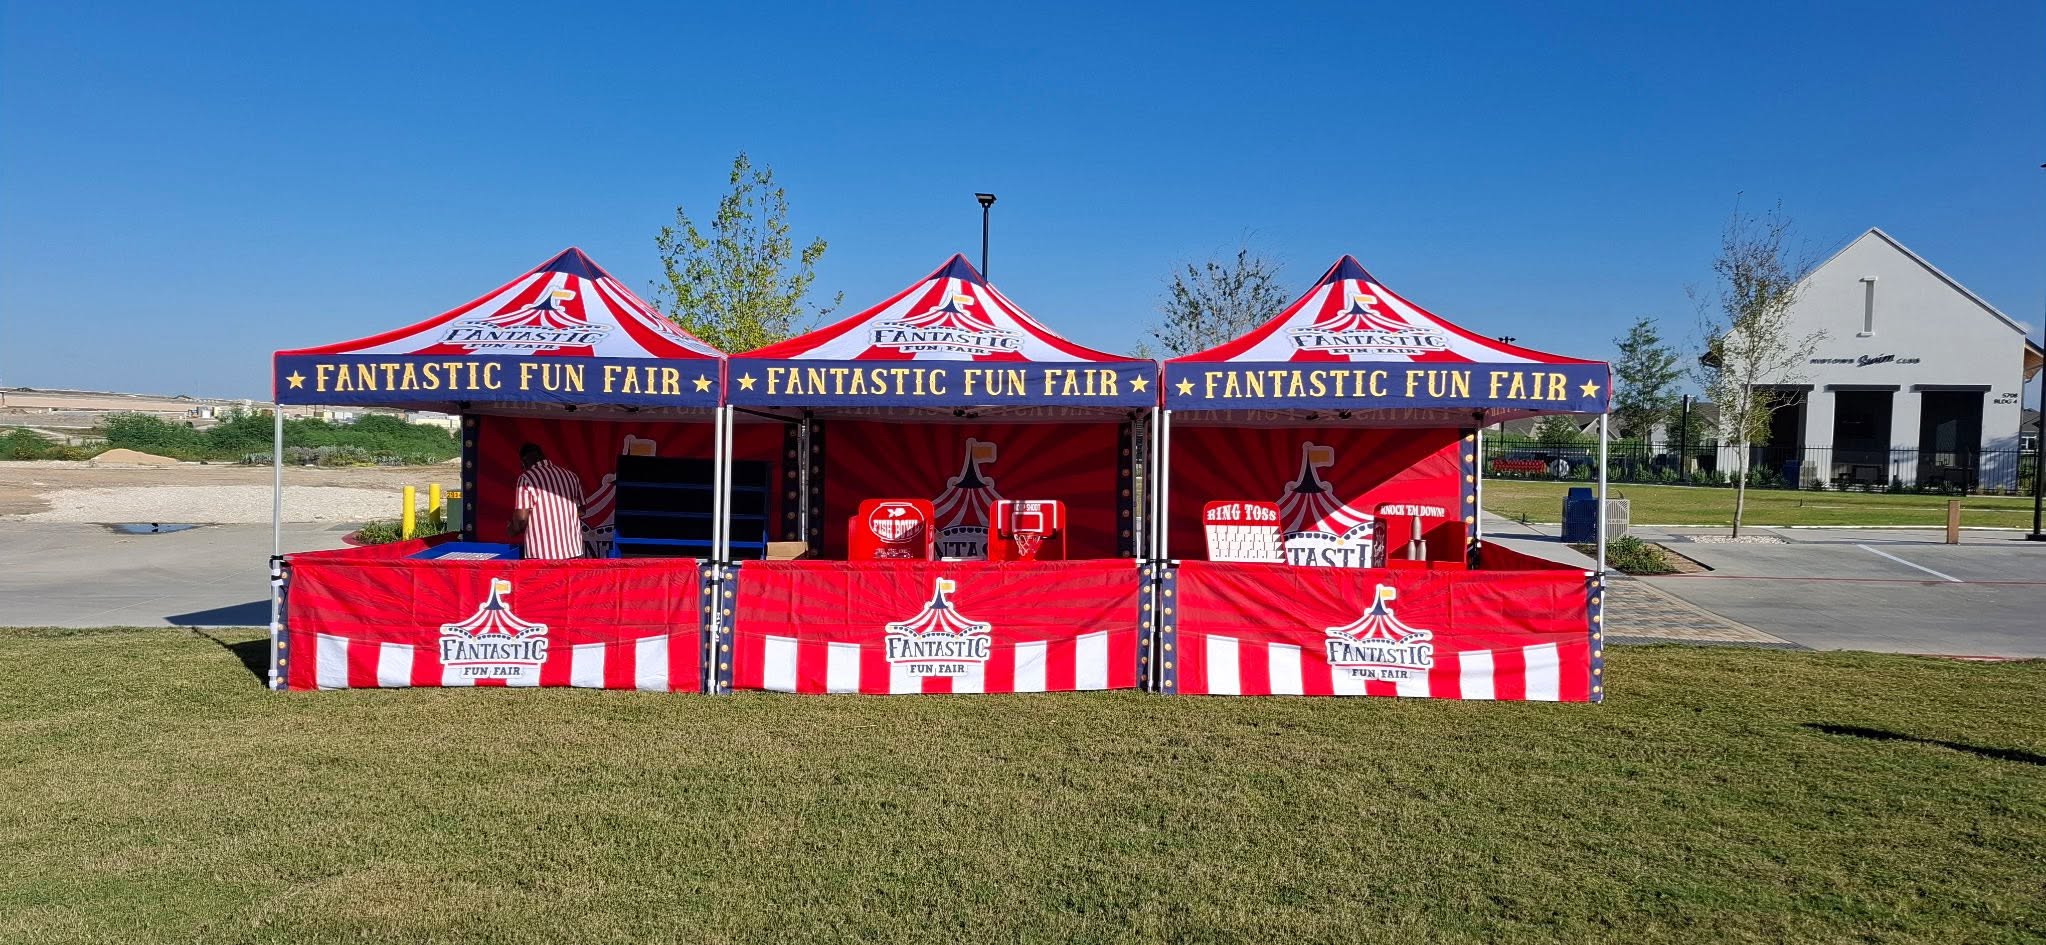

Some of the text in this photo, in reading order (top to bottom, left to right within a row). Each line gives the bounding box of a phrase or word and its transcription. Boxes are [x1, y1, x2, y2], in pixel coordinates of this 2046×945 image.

[445, 329, 603, 344] FANTASTIC
[874, 330, 1020, 349] FANTASTIC
[1292, 335, 1446, 347] FANTASTIC
[946, 346, 985, 354] FAIR
[1856, 353, 1895, 368] Swim
[316, 362, 681, 395] FANTASTIC FUN FAIR
[767, 367, 1118, 396] FANTASTIC FUN FAIR
[1205, 370, 1567, 400] FANTASTIC FUN FAIR
[1207, 503, 1277, 521] RING TOSS
[1380, 504, 1405, 516] KNOCK
[1420, 505, 1445, 517] DOWN!
[873, 519, 920, 539] FISH BOWL
[1288, 543, 1370, 568] TASTI
[441, 639, 546, 661] FANTASTIC
[888, 637, 989, 659] FANTASTIC
[1328, 641, 1431, 666] FANTASTIC
[463, 666, 521, 676] FUN FAIR
[910, 664, 965, 673] FUN FAIR
[1352, 668, 1409, 679] FUN FAIR
